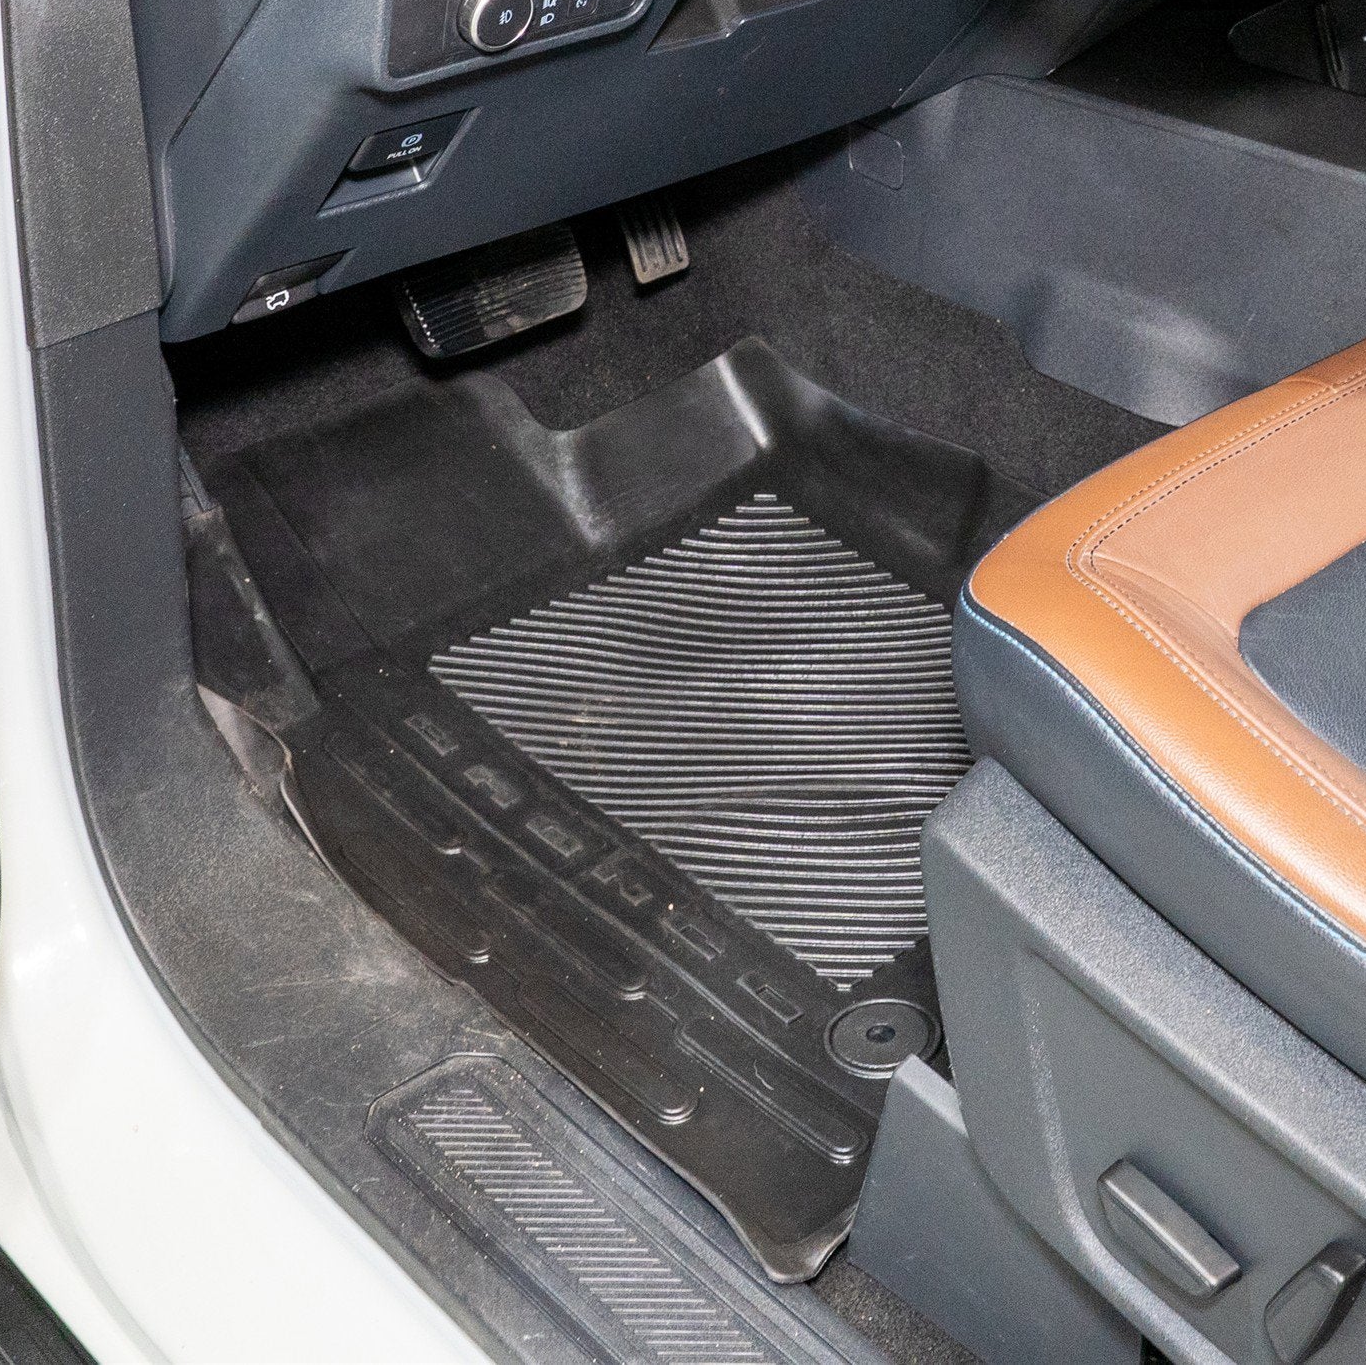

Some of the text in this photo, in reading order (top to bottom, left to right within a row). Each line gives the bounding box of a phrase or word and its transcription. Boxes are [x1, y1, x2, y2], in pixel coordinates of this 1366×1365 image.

[386, 145, 423, 160] PULL ON
[404, 713, 806, 1025] BRONCO
